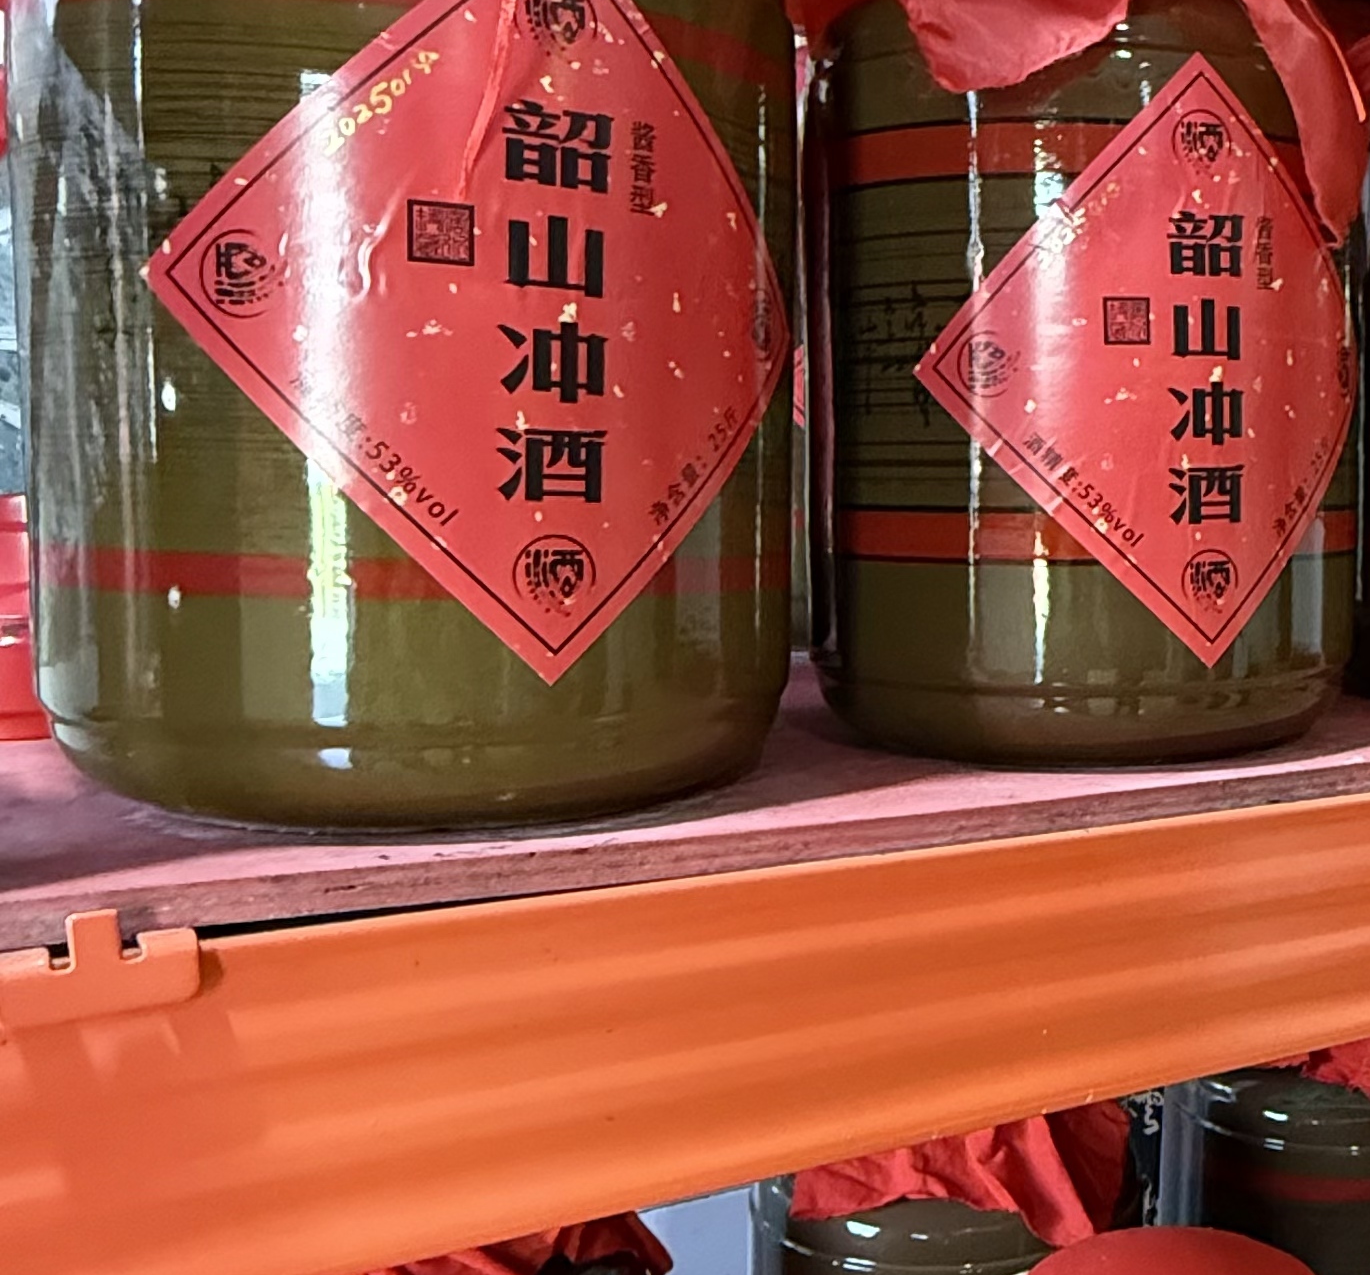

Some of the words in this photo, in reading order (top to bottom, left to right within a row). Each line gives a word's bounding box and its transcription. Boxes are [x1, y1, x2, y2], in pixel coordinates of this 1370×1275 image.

[289, 376, 459, 527] 度:53%vol
[495, 99, 615, 504] 韶山冲酒
[1167, 210, 1246, 525] 韶山冲酒
